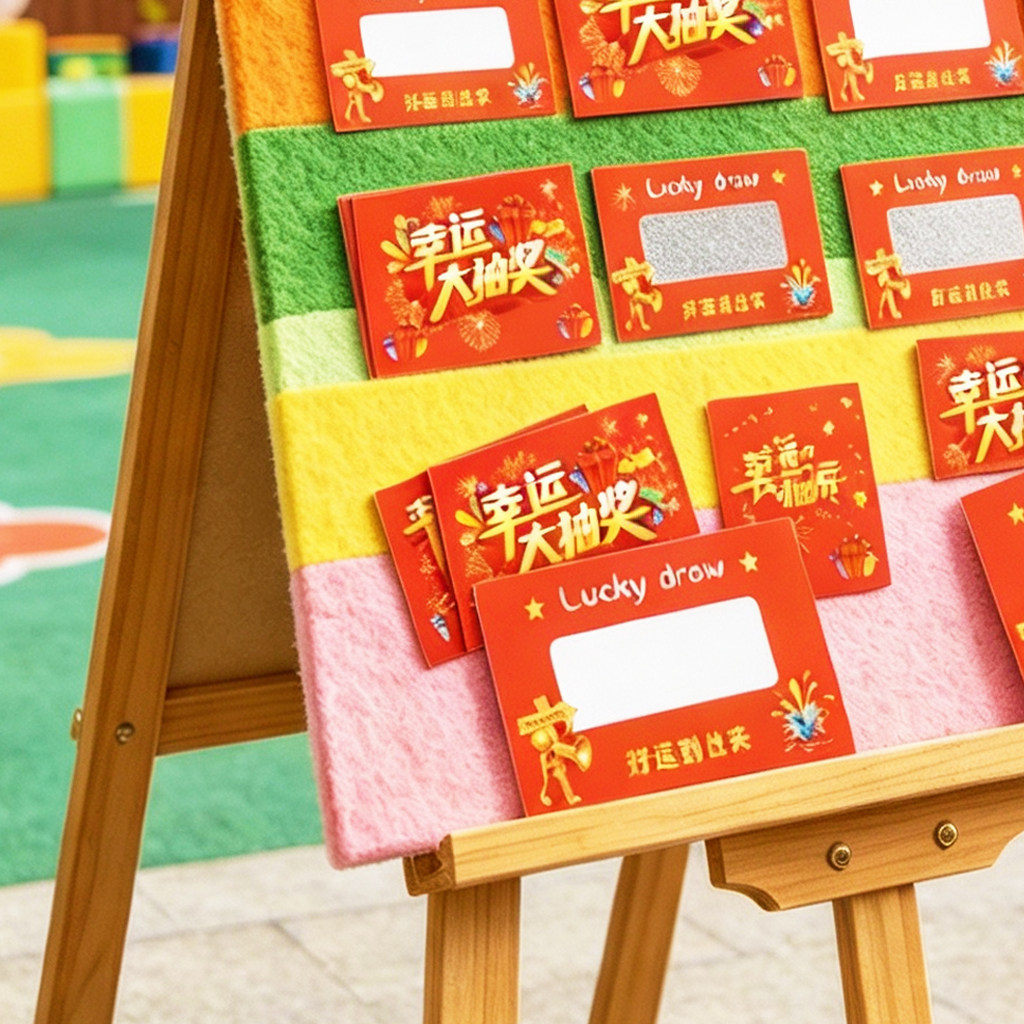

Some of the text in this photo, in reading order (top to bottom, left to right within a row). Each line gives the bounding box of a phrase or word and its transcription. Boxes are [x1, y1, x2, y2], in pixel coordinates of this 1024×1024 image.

[404, 208, 493, 288] 幸运
[478, 459, 582, 561] 幸运
[558, 573, 646, 612] Lucky
